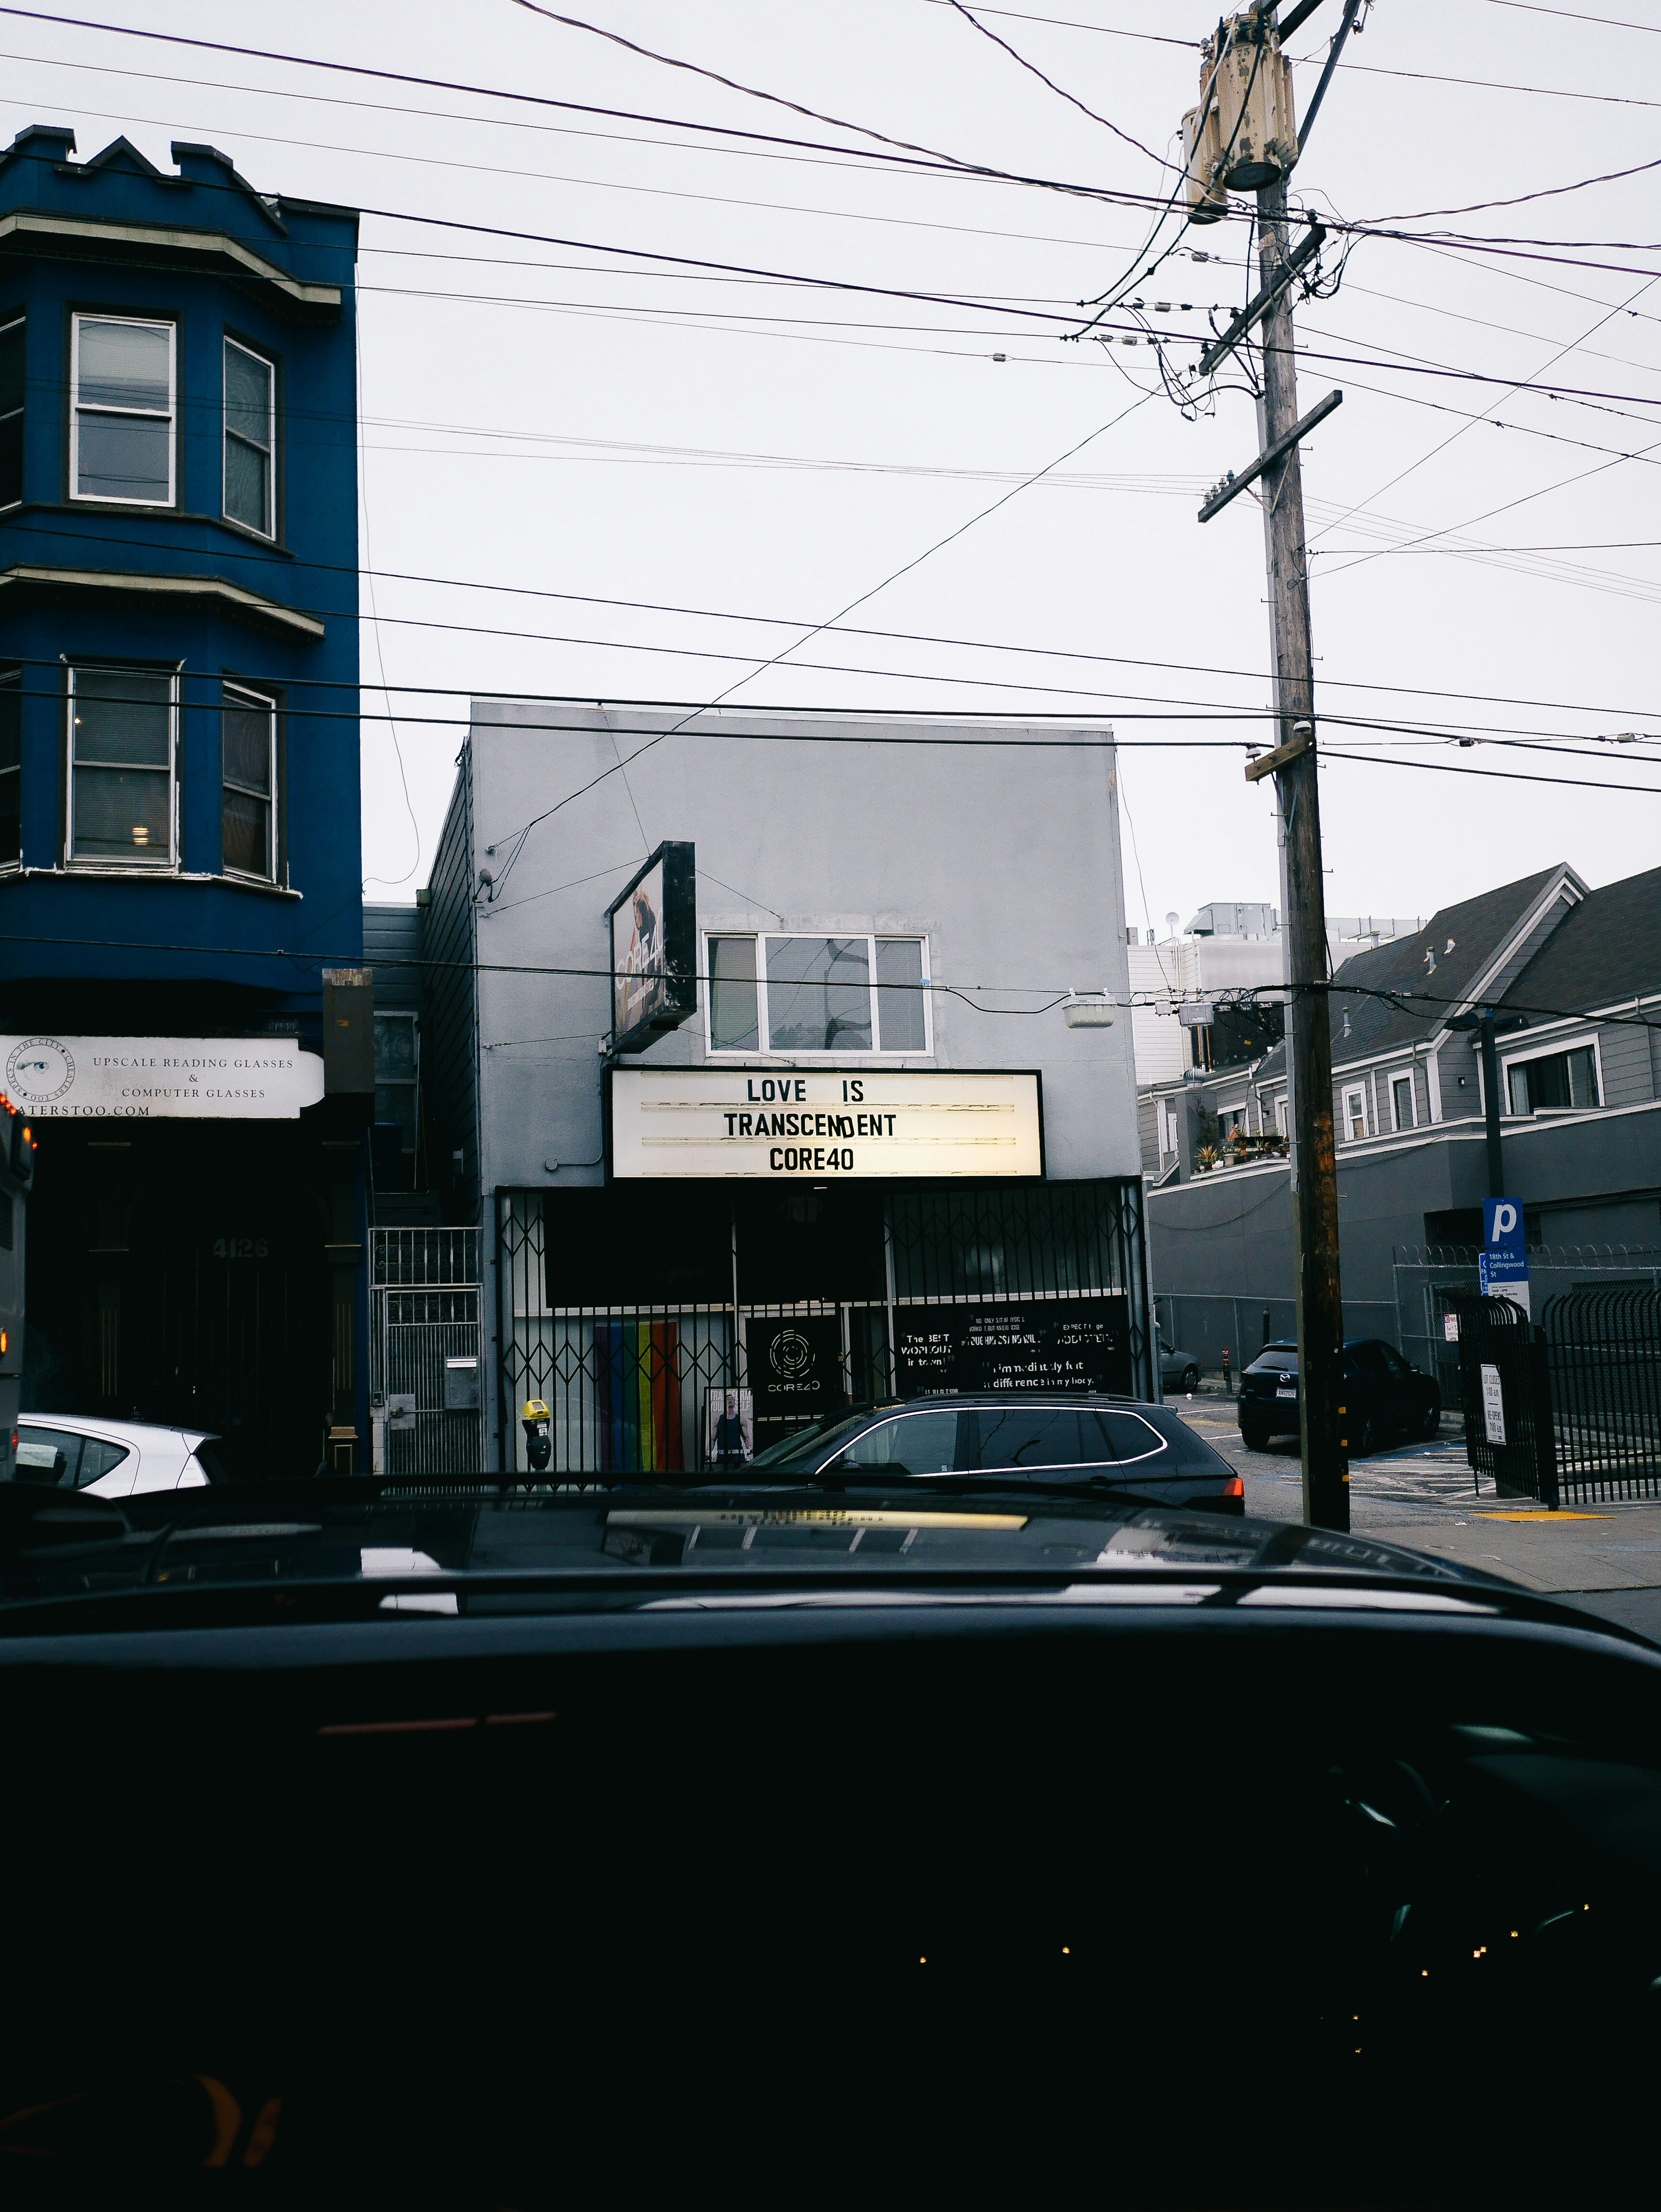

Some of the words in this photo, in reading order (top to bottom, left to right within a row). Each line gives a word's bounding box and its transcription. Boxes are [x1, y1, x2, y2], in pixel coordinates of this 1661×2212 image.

[9, 1054, 17, 1063] IN
[17, 1040, 34, 1052] THE
[39, 1040, 61, 1049] CITY
[93, 1057, 157, 1067] UPSCALE
[163, 1058, 227, 1068] READING
[234, 1059, 293, 1069] GLASSES
[189, 1074, 198, 1082] &
[122, 1088, 200, 1098] COMPUTER
[206, 1089, 265, 1098] GLASSES
[747, 1079, 806, 1102] LOVE
[842, 1079, 864, 1102] IS
[18, 1106, 149, 1116] ATERSTOO.COM
[724, 1113, 896, 1138] TRANSCENDENT
[769, 1147, 854, 1171] CORE40
[212, 1238, 268, 1258] 4126
[1490, 1261, 1524, 1269] Collingwood
[907, 1335, 923, 1343] The
[768, 1381, 820, 1392] CORE40
